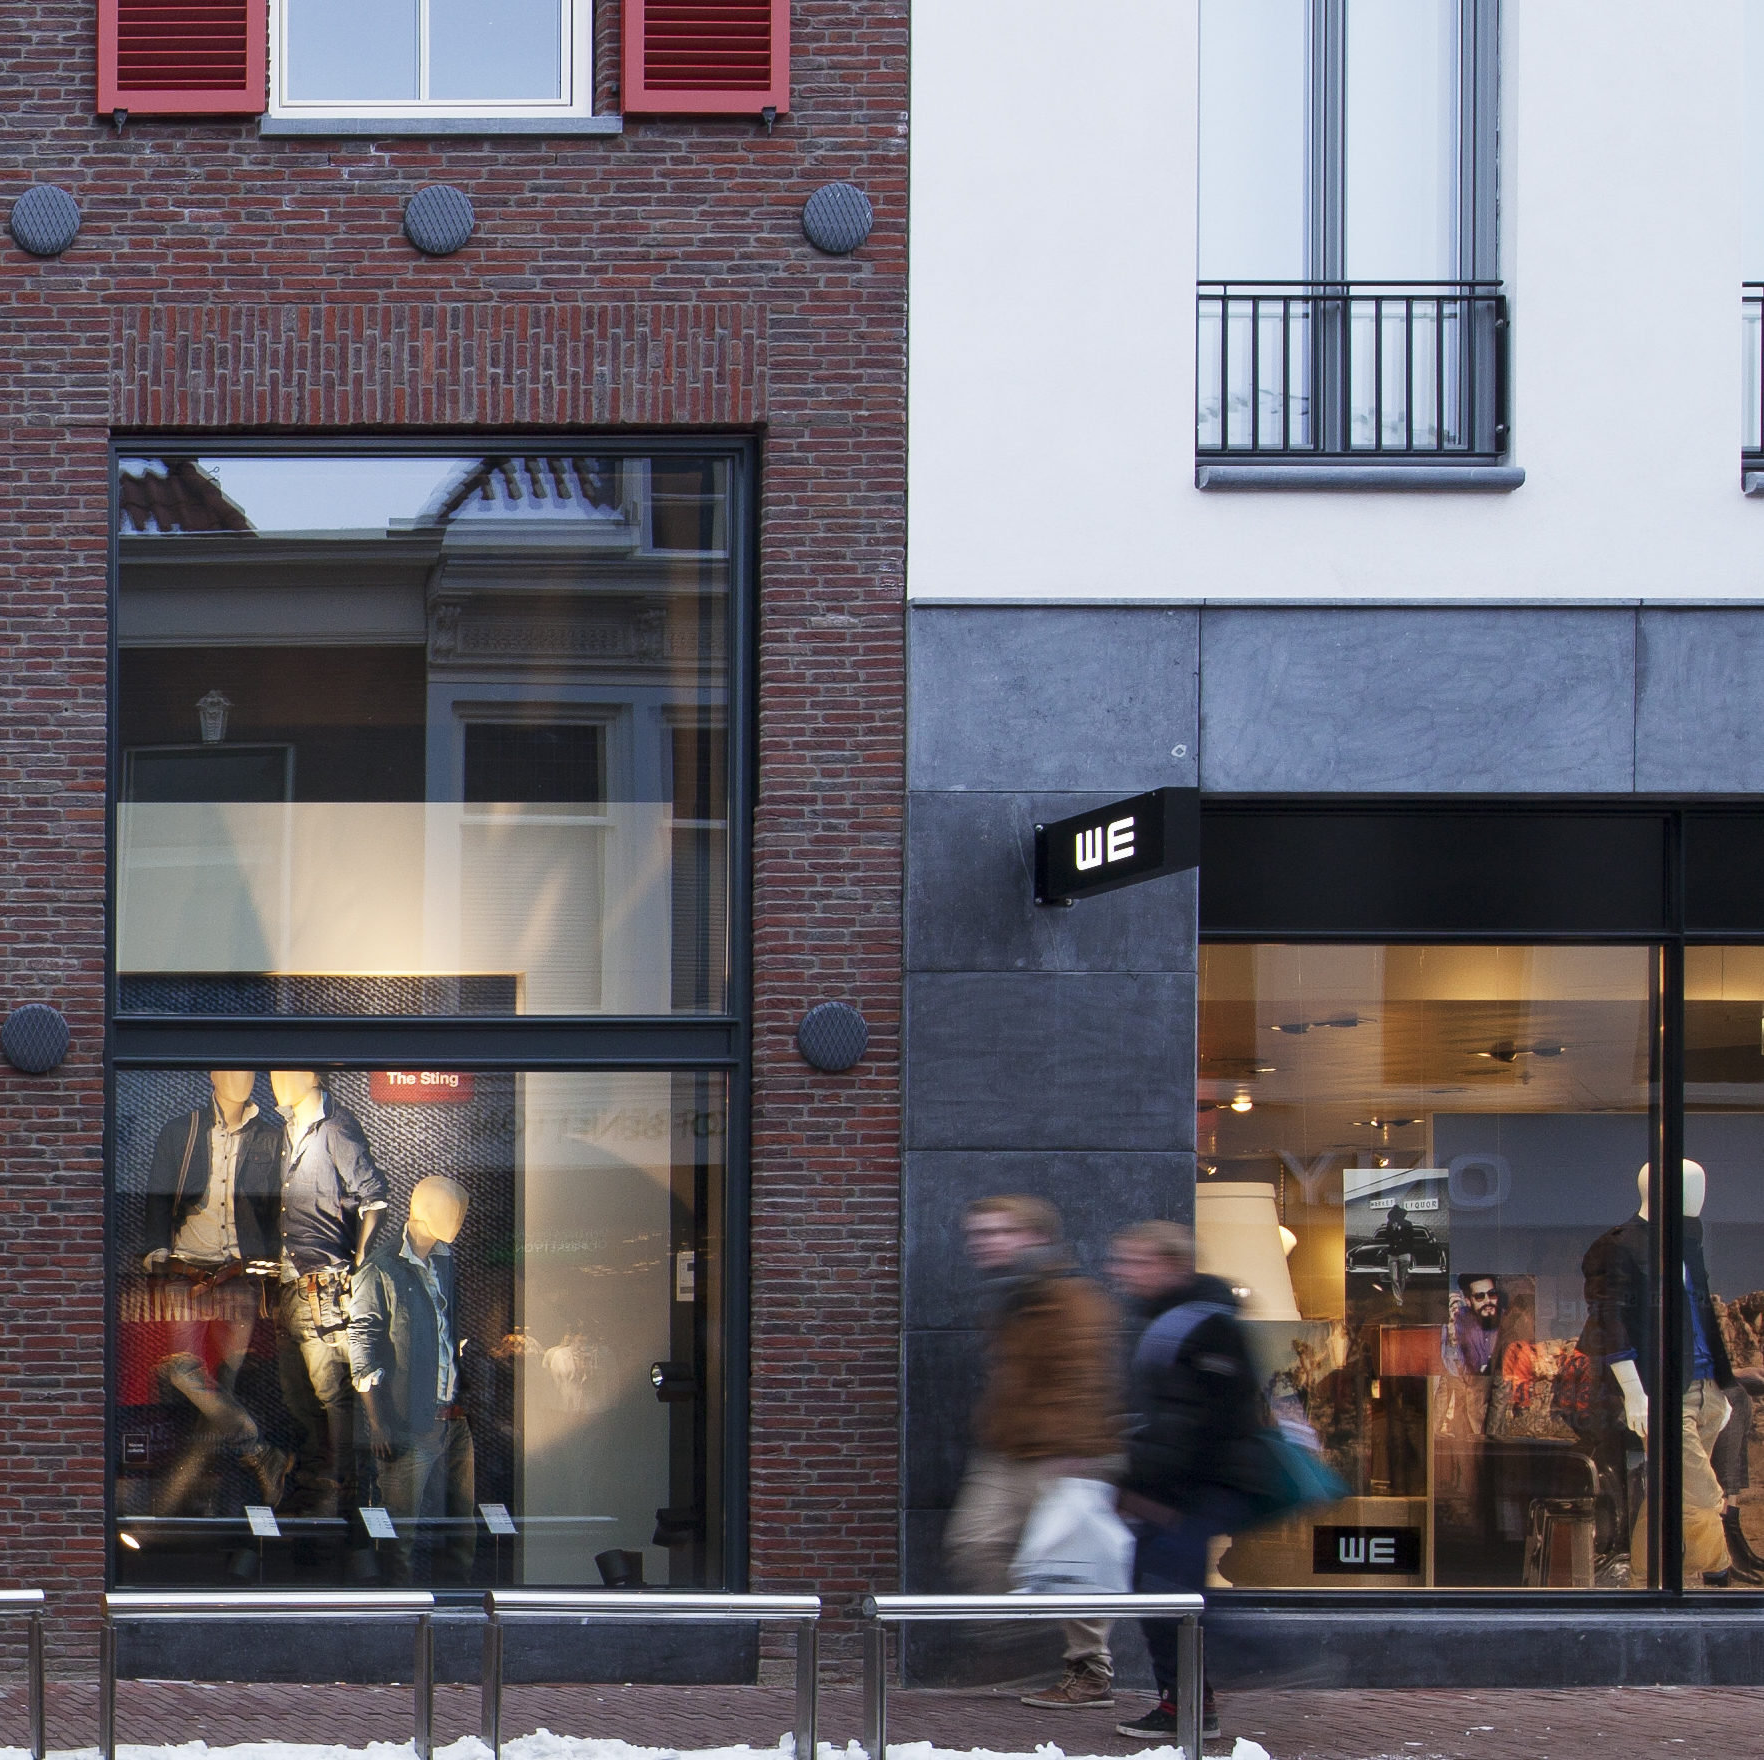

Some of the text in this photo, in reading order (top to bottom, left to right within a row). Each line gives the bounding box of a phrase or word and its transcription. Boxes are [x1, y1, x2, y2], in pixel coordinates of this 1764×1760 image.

[1075, 816, 1135, 871] WE
[386, 1071, 459, 1088] The Sting
[1405, 1200, 1437, 1210] LIQUOR
[1339, 1537, 1396, 1564] WE
